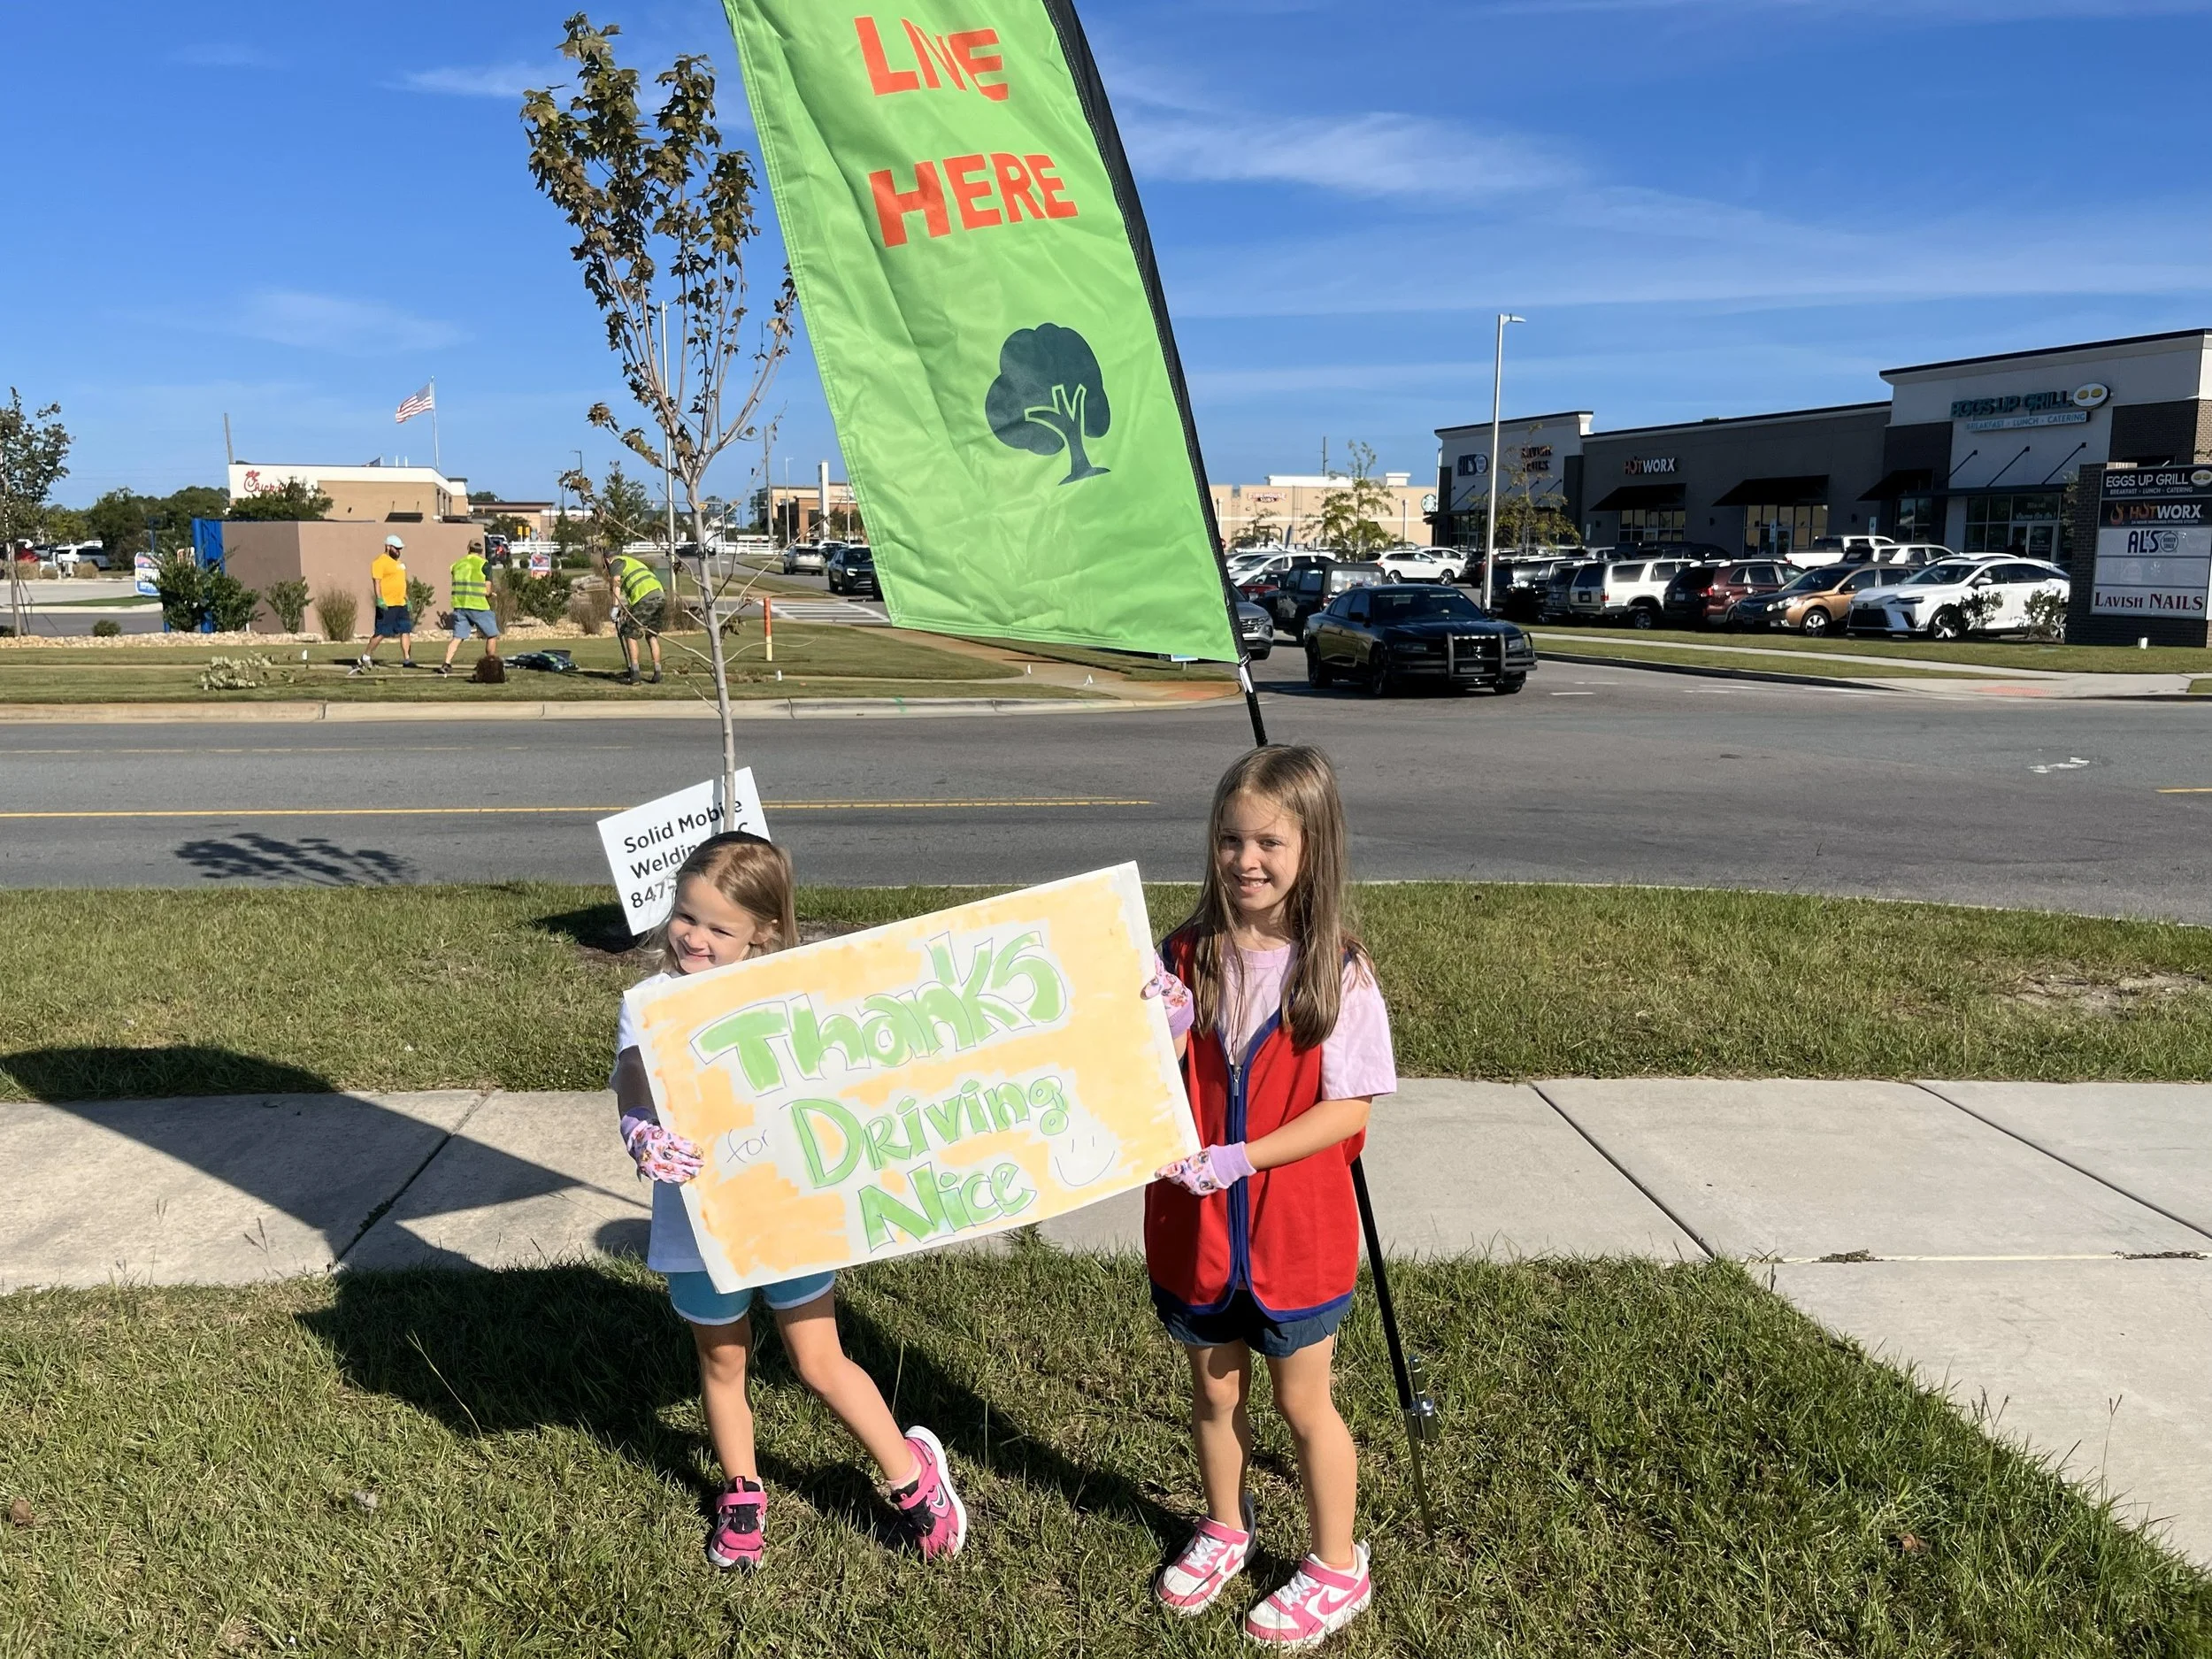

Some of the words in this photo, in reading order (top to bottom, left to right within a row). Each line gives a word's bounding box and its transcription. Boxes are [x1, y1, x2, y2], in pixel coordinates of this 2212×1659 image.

[868, 152, 1079, 248] HERE
[1998, 395, 2020, 413] UP
[2024, 390, 2073, 411] GRILL
[2013, 417, 2039, 426] LUNCH
[2047, 412, 2086, 424] CATERING
[1623, 456, 1676, 474] HOTWORX
[2106, 474, 2136, 488] EGGS
[2138, 473, 2154, 487] UP
[2155, 472, 2189, 486] GRILL
[2129, 502, 2202, 519] HOTWORX
[2094, 592, 2143, 608] LAVISH
[2149, 594, 2203, 611] NAILS
[624, 821, 674, 854] Solid
[677, 800, 743, 833] Mobie
[630, 842, 698, 879] Weldin
[726, 1128, 769, 1164] for
[857, 1161, 1037, 1254] Nice
